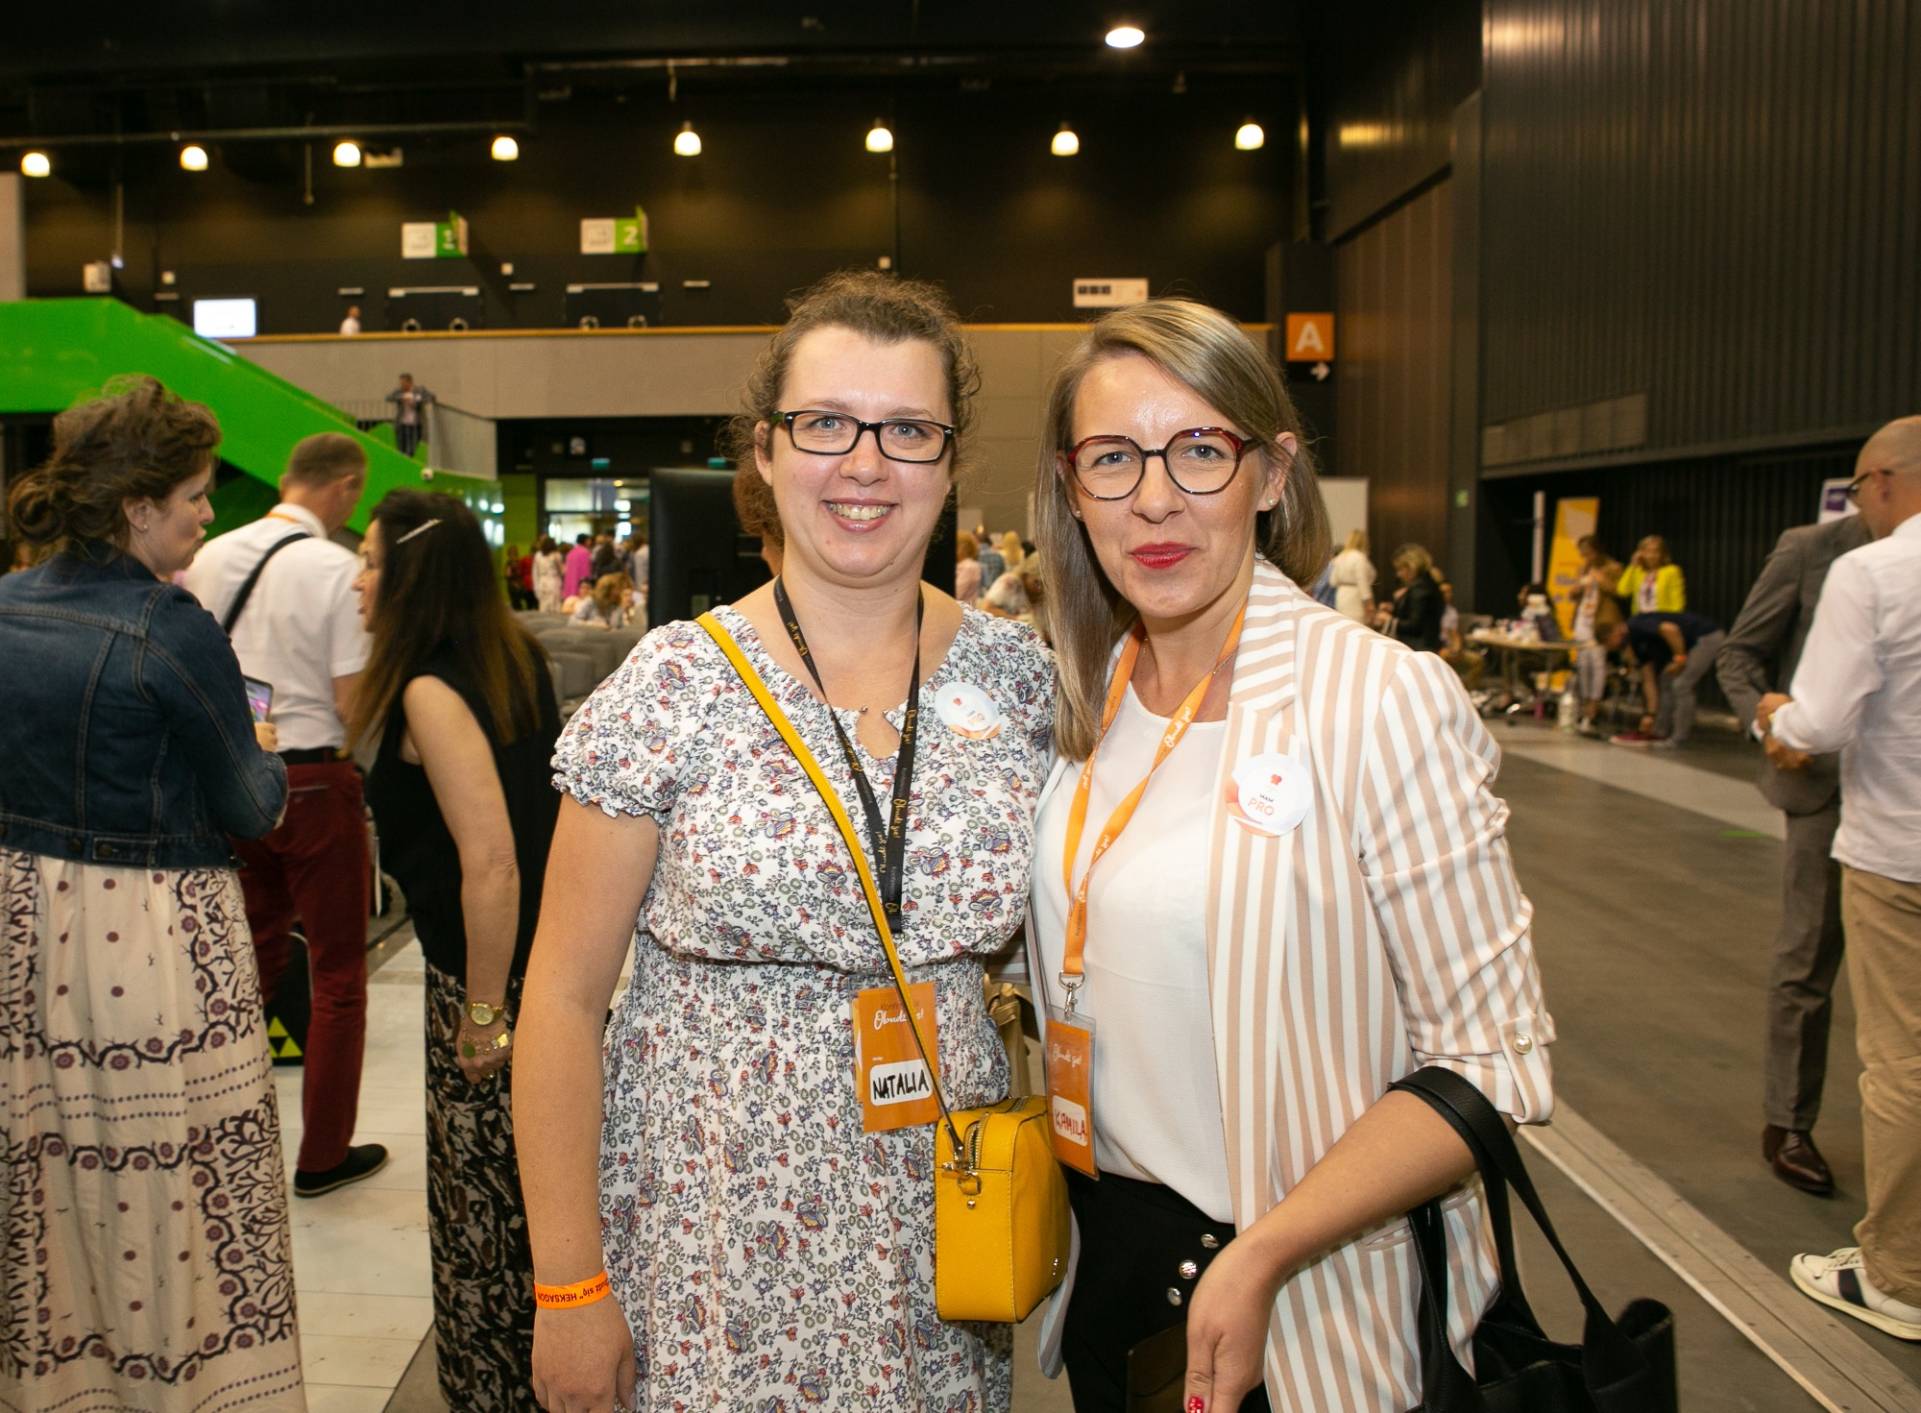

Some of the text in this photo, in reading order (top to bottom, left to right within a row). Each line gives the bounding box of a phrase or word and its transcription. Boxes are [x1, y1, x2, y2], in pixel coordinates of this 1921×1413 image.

[623, 226, 638, 245] 2
[1295, 320, 1325, 353] A
[1248, 798, 1274, 816] PRO
[872, 1069, 929, 1100] NATALIA
